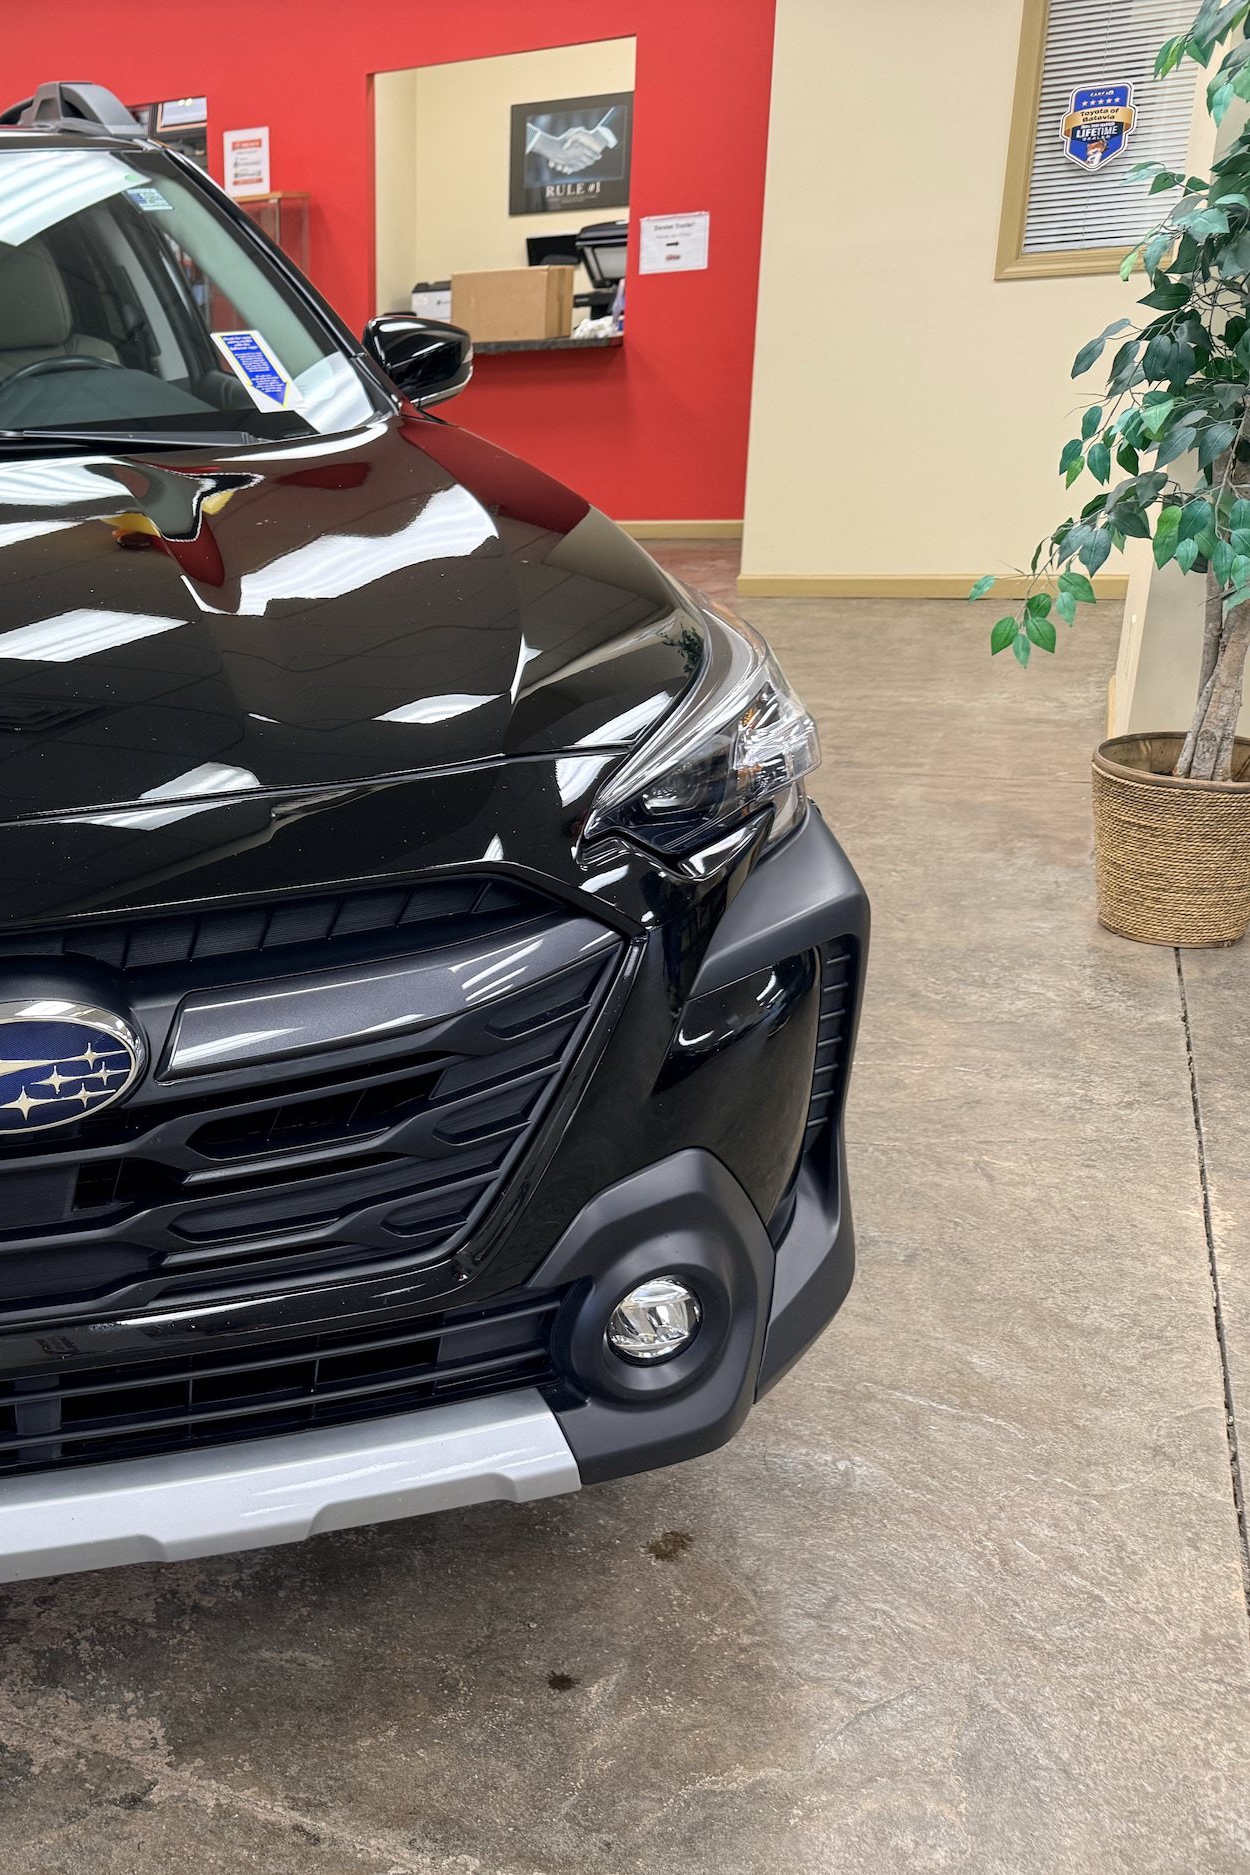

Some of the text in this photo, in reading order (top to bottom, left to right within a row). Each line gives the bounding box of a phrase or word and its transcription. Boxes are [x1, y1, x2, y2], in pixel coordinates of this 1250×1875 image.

[1080, 108, 1109, 117] Toyota
[1082, 114, 1115, 122] Batavia
[1075, 126, 1118, 139] LIFETIME
[545, 182, 586, 198] RULE
